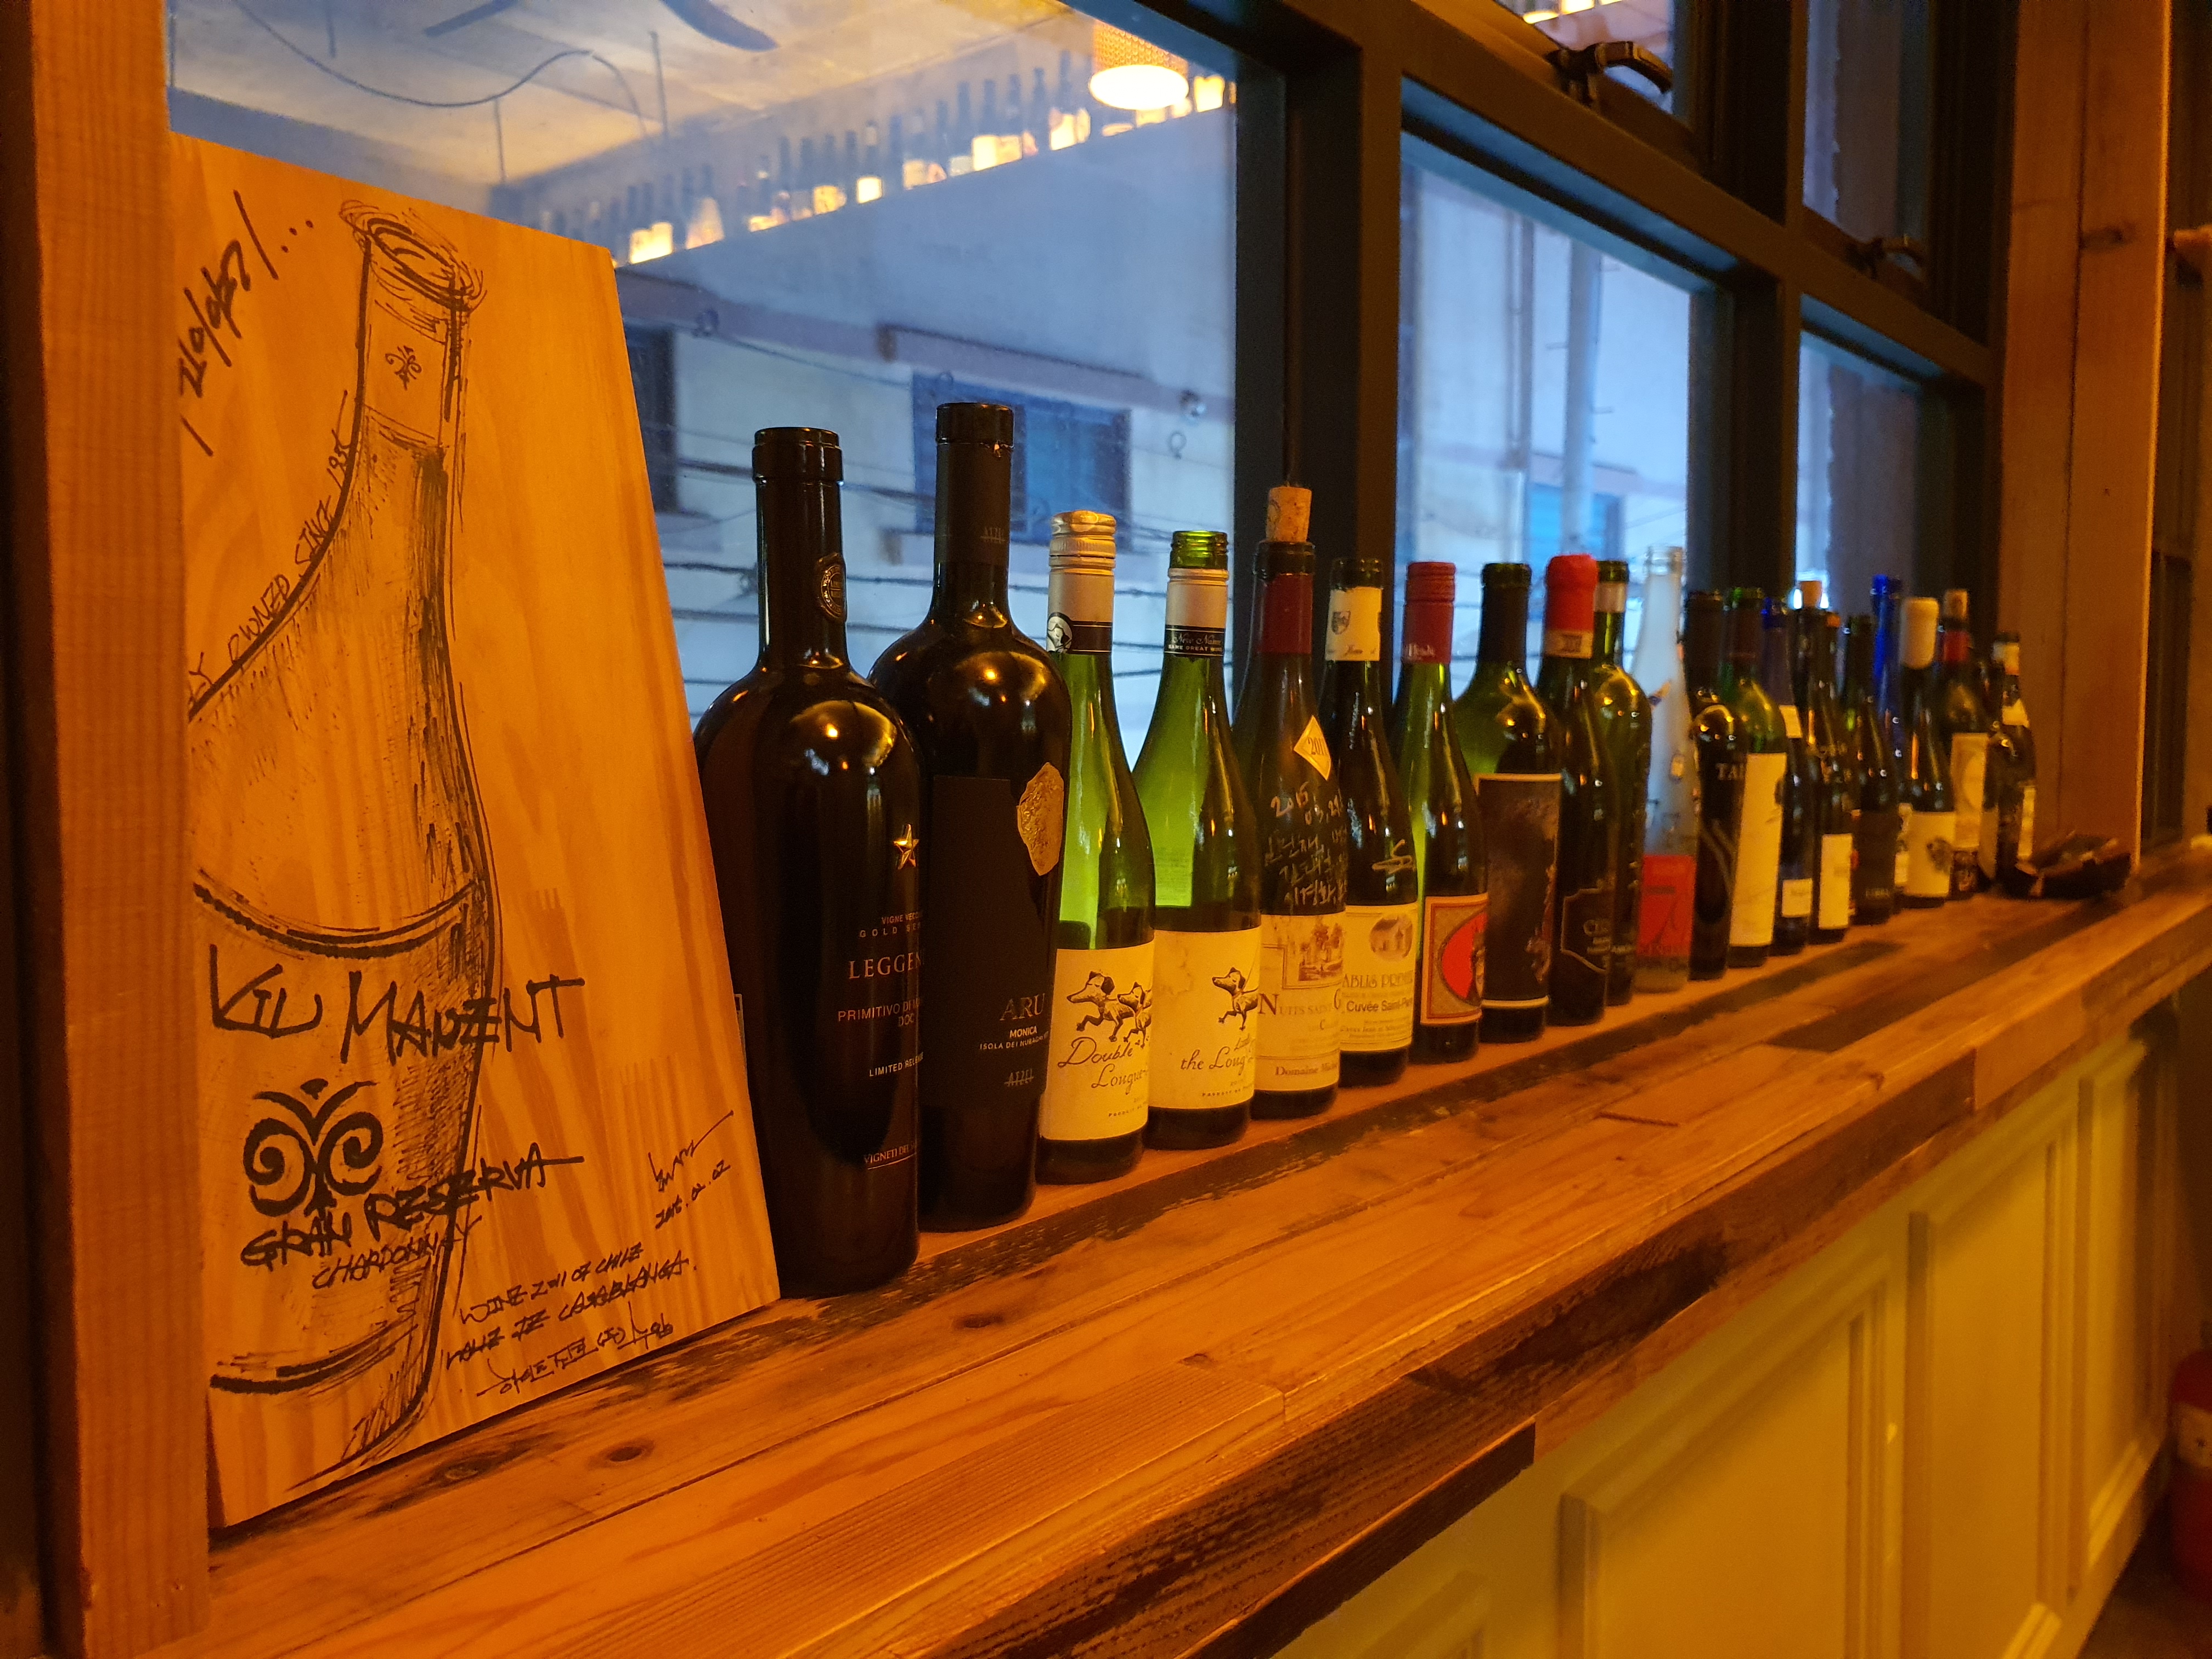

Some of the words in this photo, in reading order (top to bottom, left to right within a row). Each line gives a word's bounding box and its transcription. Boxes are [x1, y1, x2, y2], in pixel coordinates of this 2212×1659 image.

[882, 914, 904, 925] VIGNE
[859, 926, 898, 938] GOLD
[837, 1003, 900, 1022] PRIMITIVO
[1009, 1025, 1038, 1039] MONICA
[1006, 1041, 1018, 1049] DEI
[1057, 1036, 1133, 1068] Double
[1180, 1049, 1204, 1070] the
[869, 1062, 903, 1077] LIMITED
[864, 1148, 898, 1164] VIGNETI
